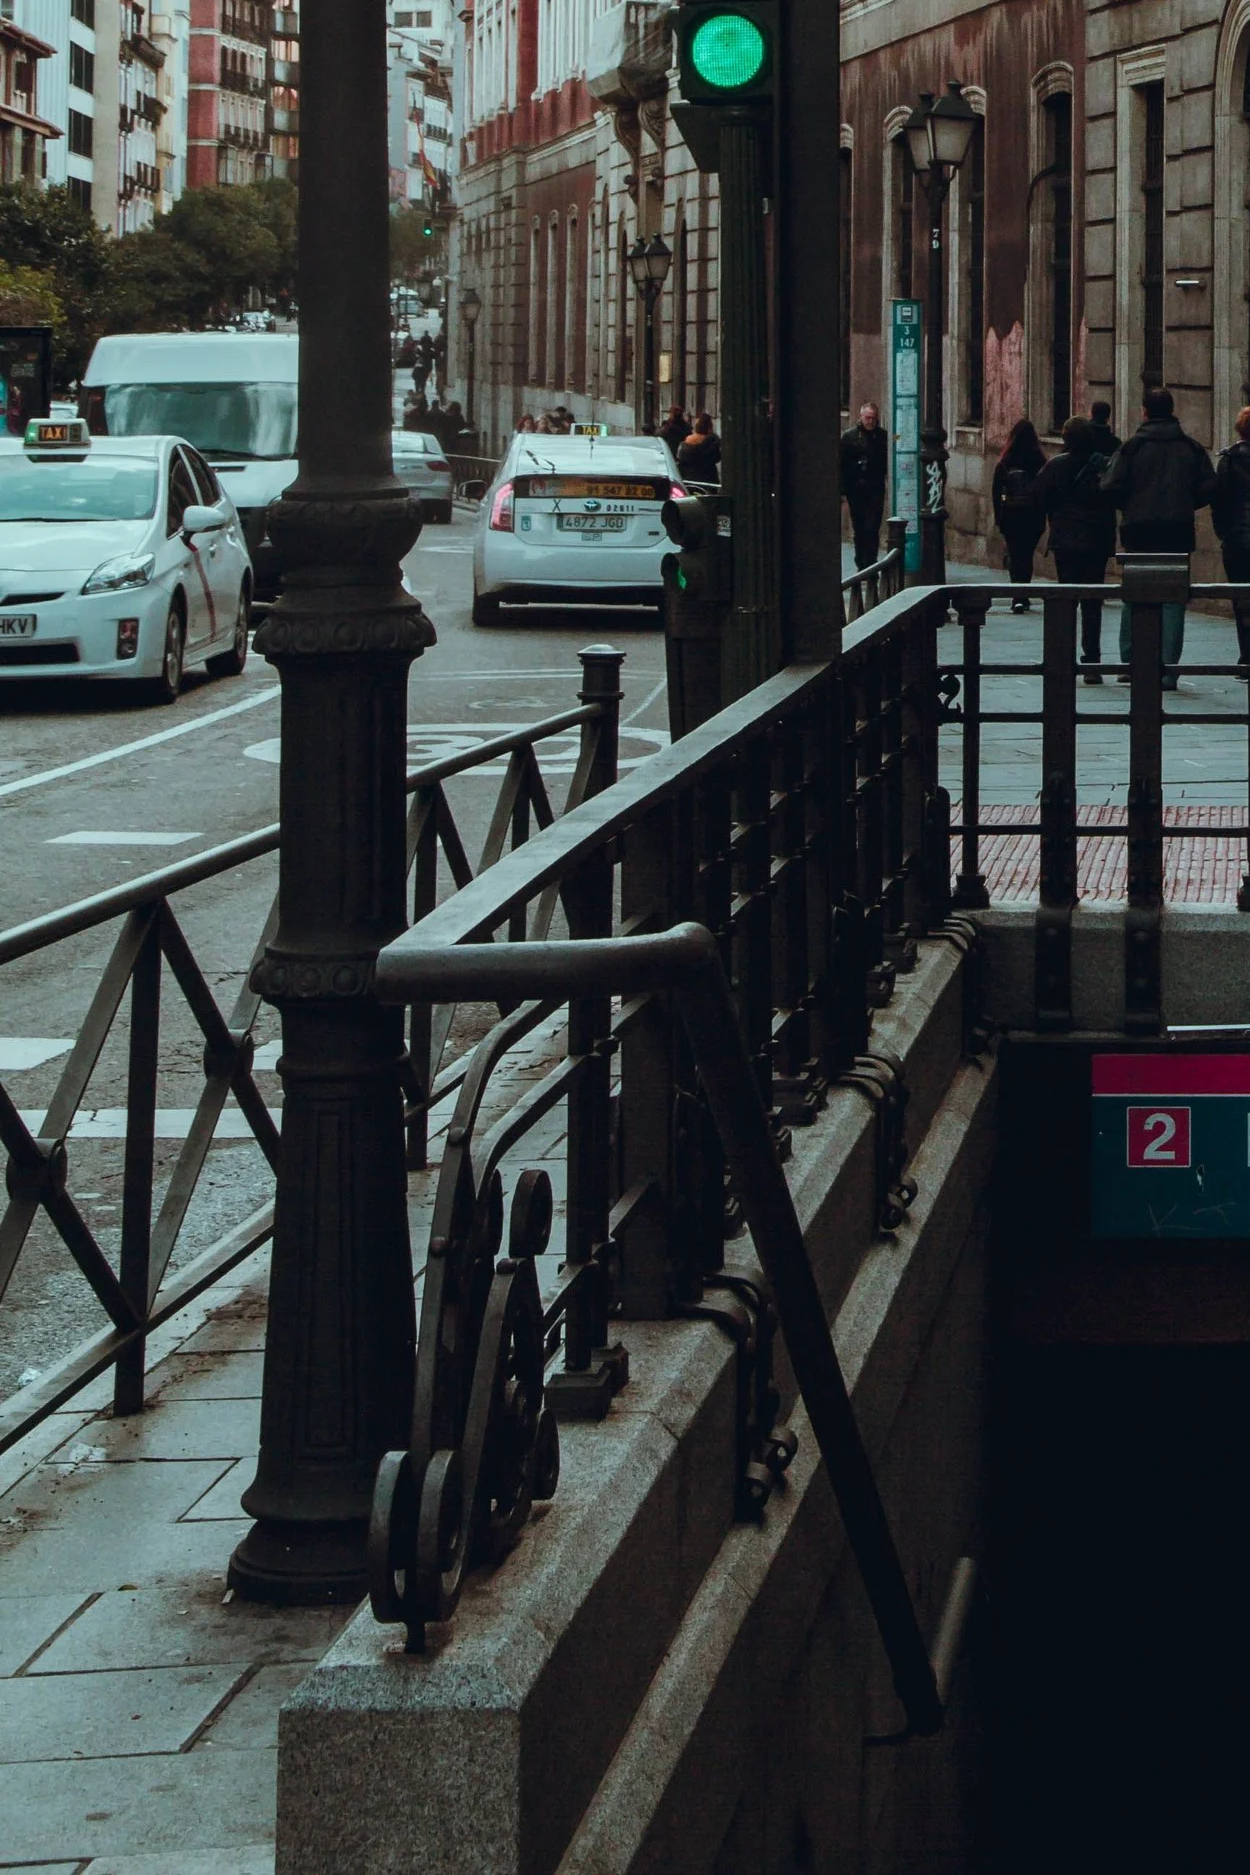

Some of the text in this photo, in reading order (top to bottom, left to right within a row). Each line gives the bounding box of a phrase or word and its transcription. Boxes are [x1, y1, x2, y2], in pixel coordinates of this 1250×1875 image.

[900, 338, 915, 347] 147
[40, 426, 67, 440] TAXI
[565, 516, 597, 529] 4872
[1143, 1113, 1177, 1161] 2
